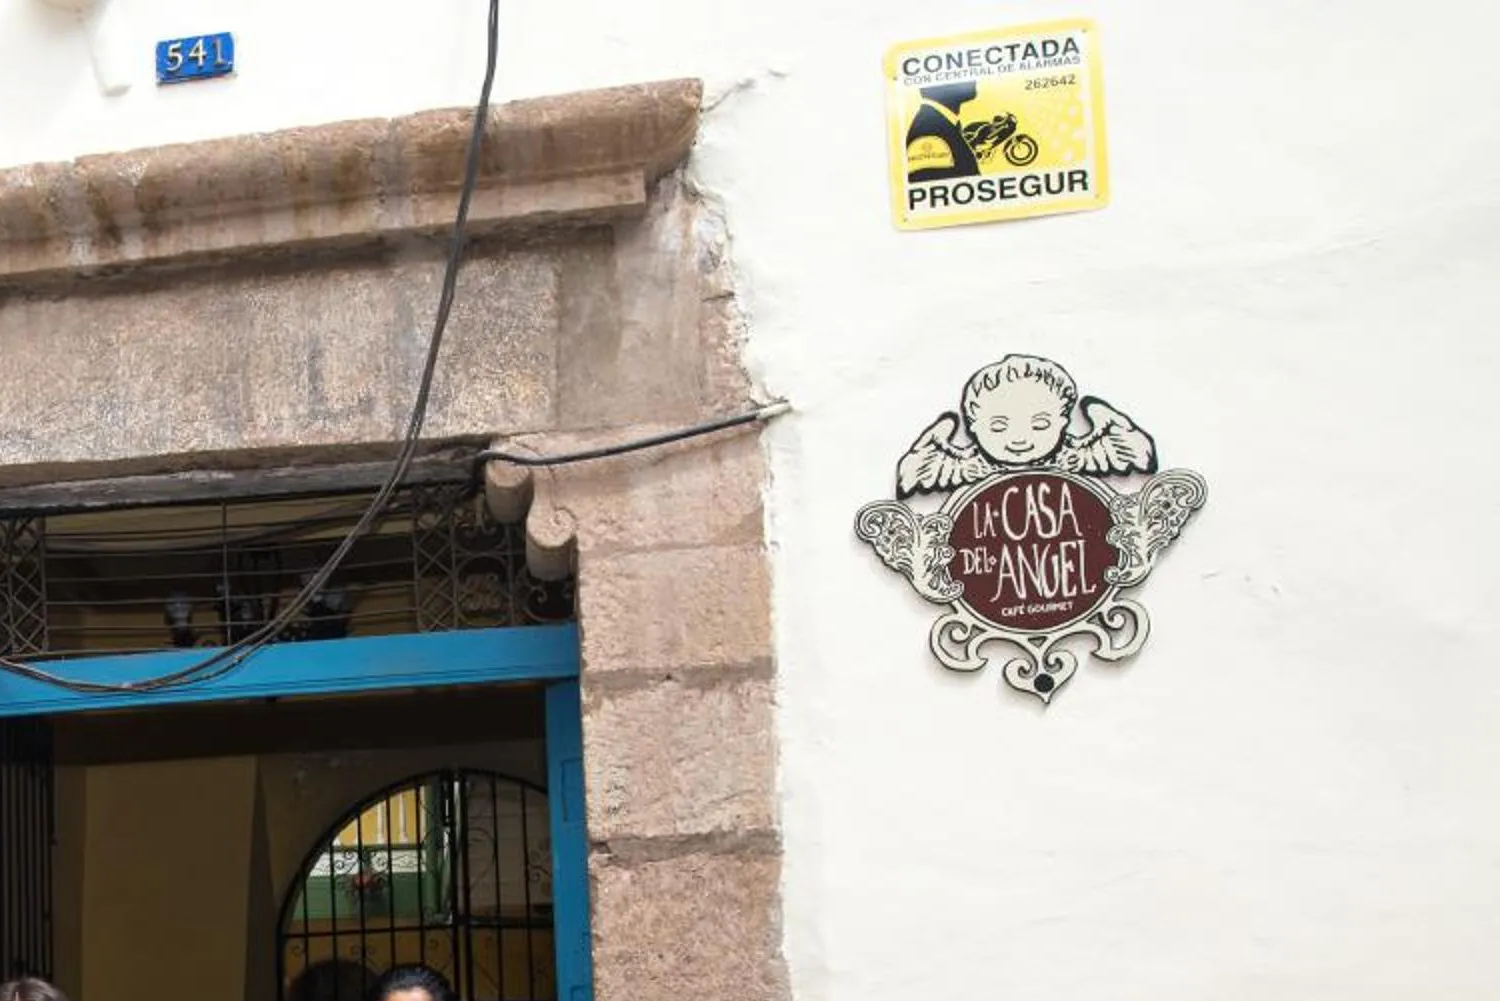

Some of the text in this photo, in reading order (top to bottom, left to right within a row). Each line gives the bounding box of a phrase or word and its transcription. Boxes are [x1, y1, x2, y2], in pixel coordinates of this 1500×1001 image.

[164, 36, 226, 71] 541
[902, 37, 1080, 77] CONECTADA
[903, 56, 1081, 87] CON CENTRAL DE ALARMAS
[908, 169, 1089, 210] PROSEGUR
[973, 481, 1083, 540] LA CASA
[960, 539, 1097, 603] DEL ANGEL
[1027, 601, 1073, 614] GOURMET
